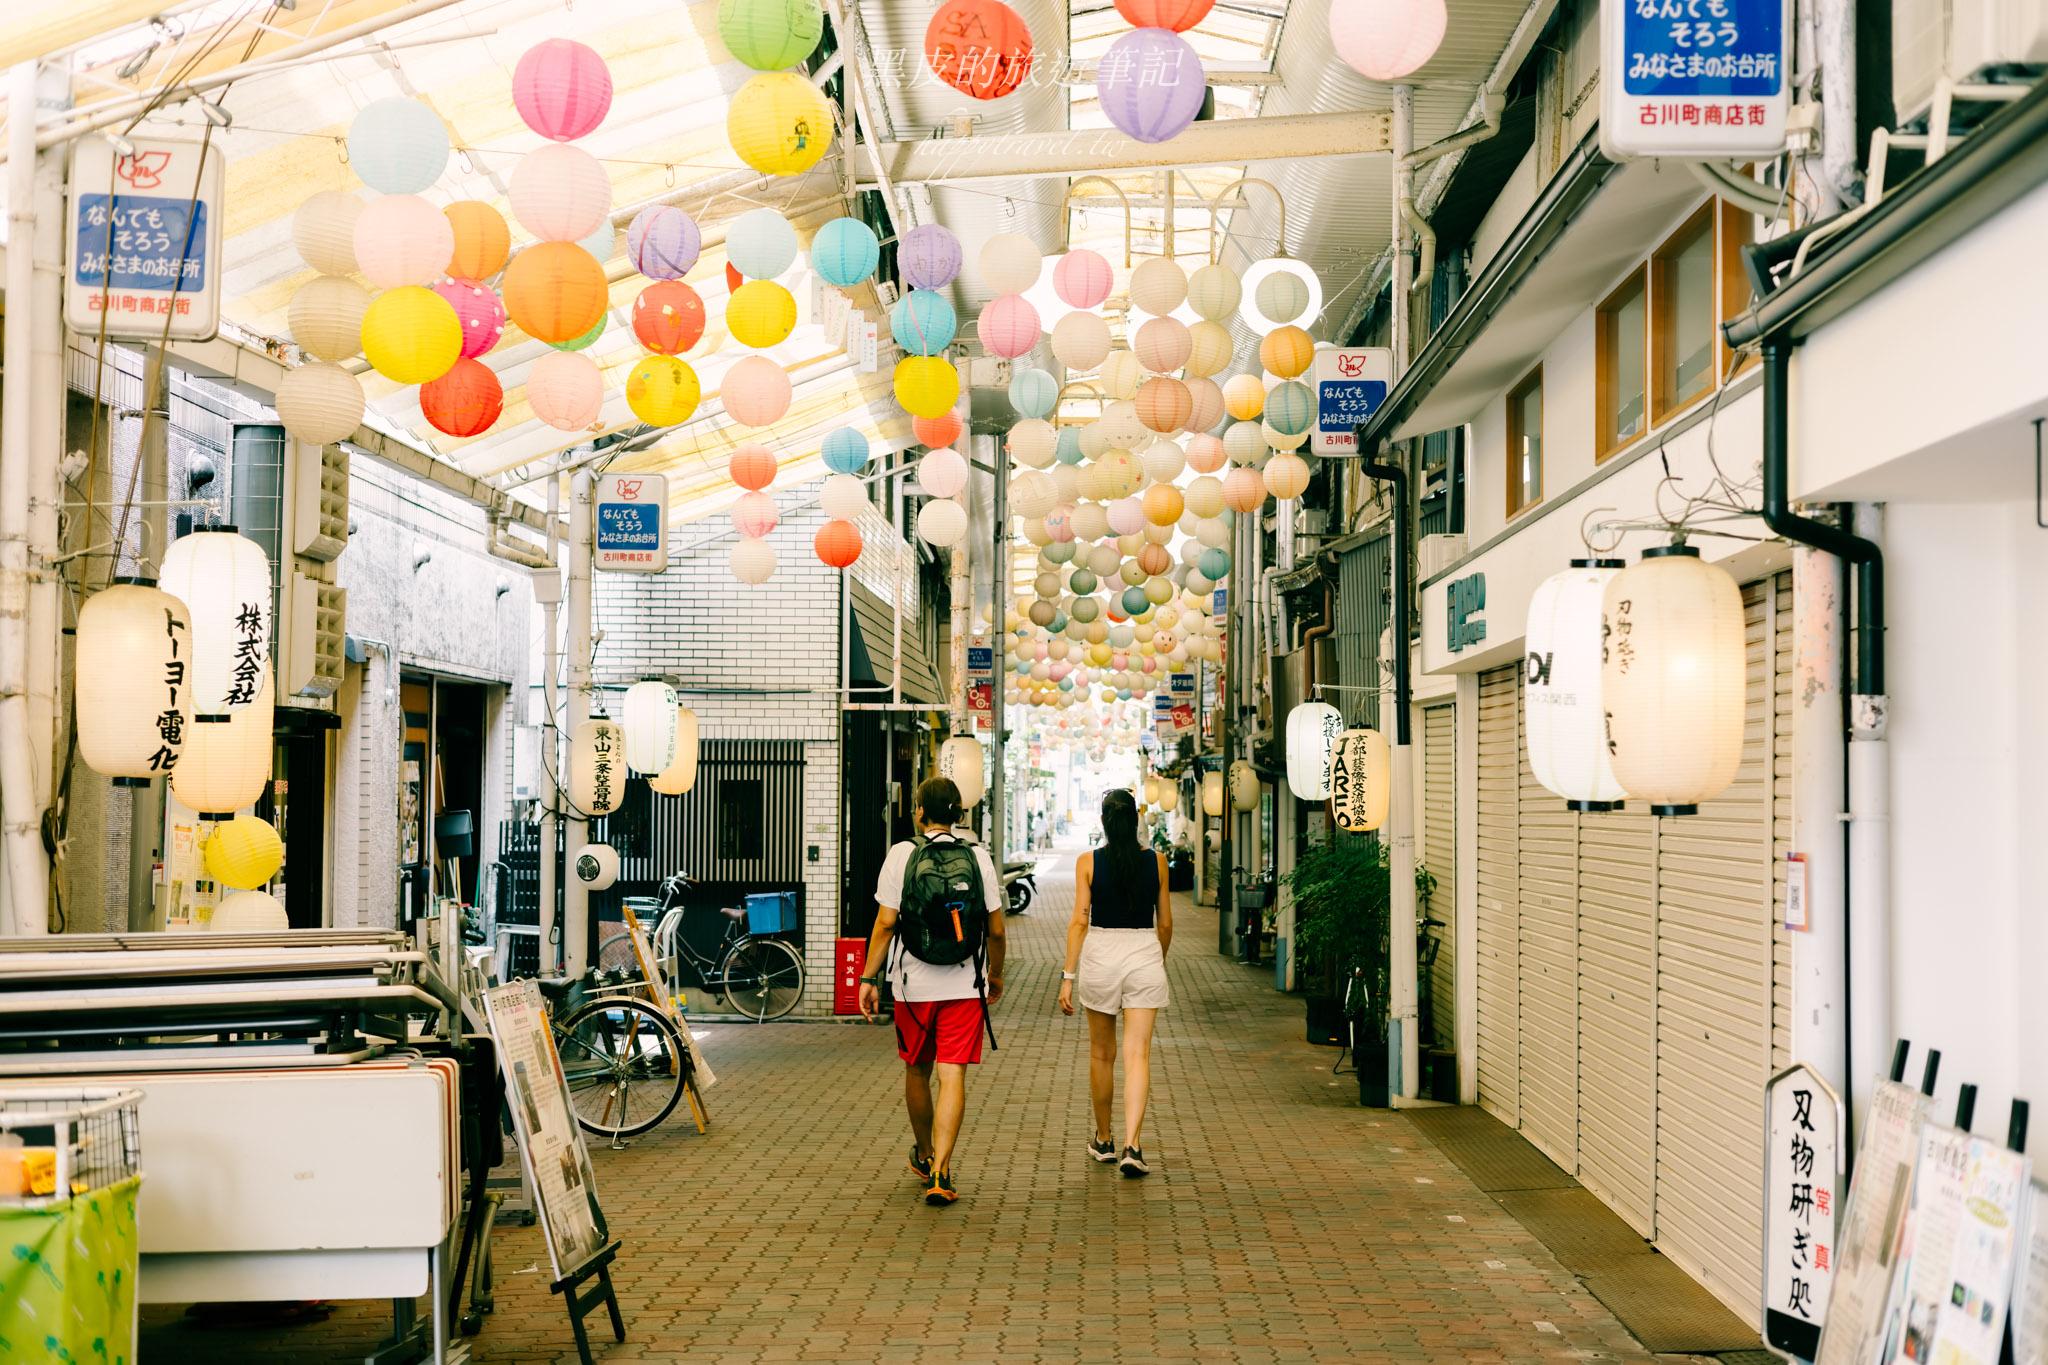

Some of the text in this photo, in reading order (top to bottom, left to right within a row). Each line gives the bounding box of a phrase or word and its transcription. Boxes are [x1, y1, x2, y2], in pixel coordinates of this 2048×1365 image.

[1669, 22, 1739, 48] そろう
[1629, 53, 1776, 79] みなさまのお台所
[1640, 103, 1766, 126] 古川町商店街
[87, 204, 164, 229] なんでも
[115, 230, 171, 252] そろう
[80, 252, 200, 278] みなさまのお台所
[88, 294, 191, 315] 古川町商店街
[1323, 387, 1364, 399] なんでも
[1338, 400, 1368, 411] そろう
[603, 508, 639, 520] なんでも
[616, 520, 643, 531] そろう
[600, 532, 657, 544] みなさまのお台所
[221, 602, 263, 705] 株式会社
[147, 607, 185, 772] トーヨー電化
[1333, 737, 1351, 828] JARFO
